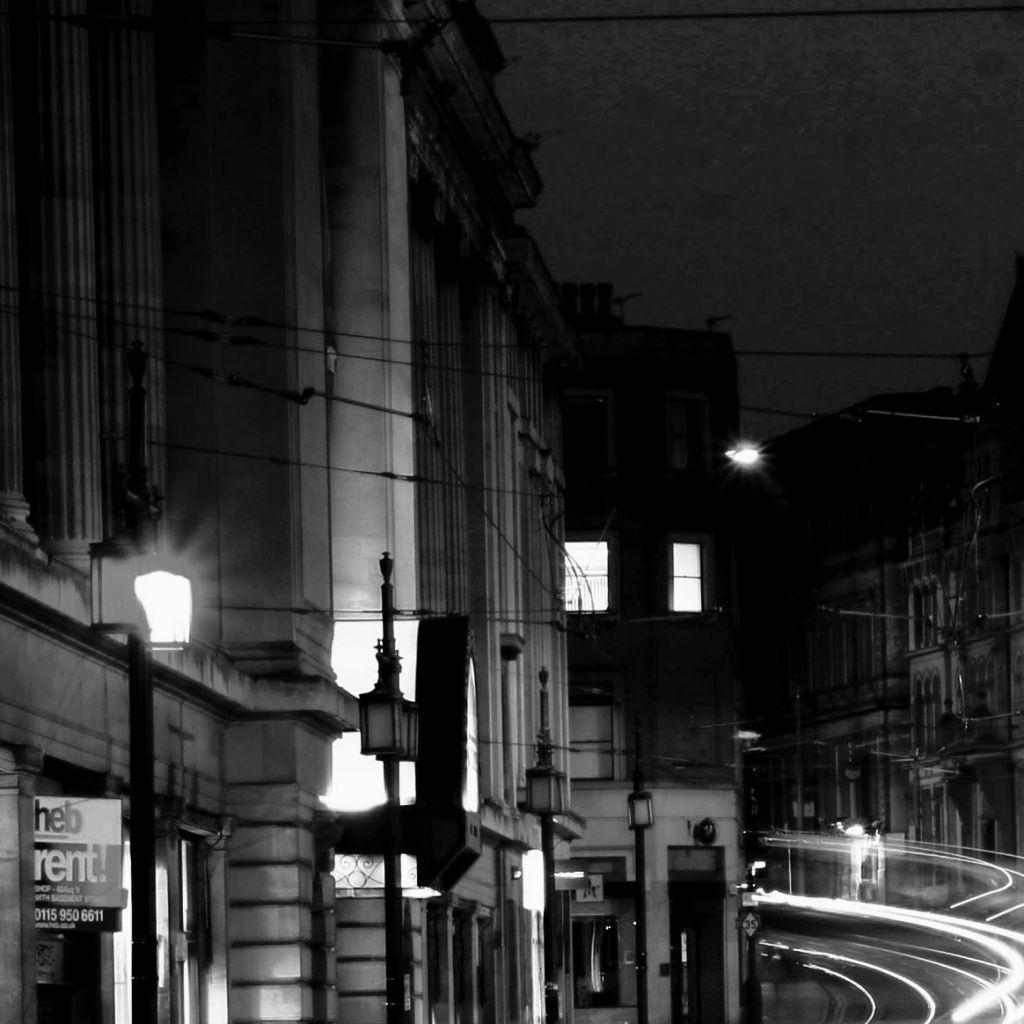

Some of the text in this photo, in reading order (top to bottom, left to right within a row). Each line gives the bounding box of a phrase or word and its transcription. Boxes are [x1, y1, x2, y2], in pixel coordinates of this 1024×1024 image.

[34, 798, 82, 835] heb
[35, 908, 104, 922] 0115 950 6611
